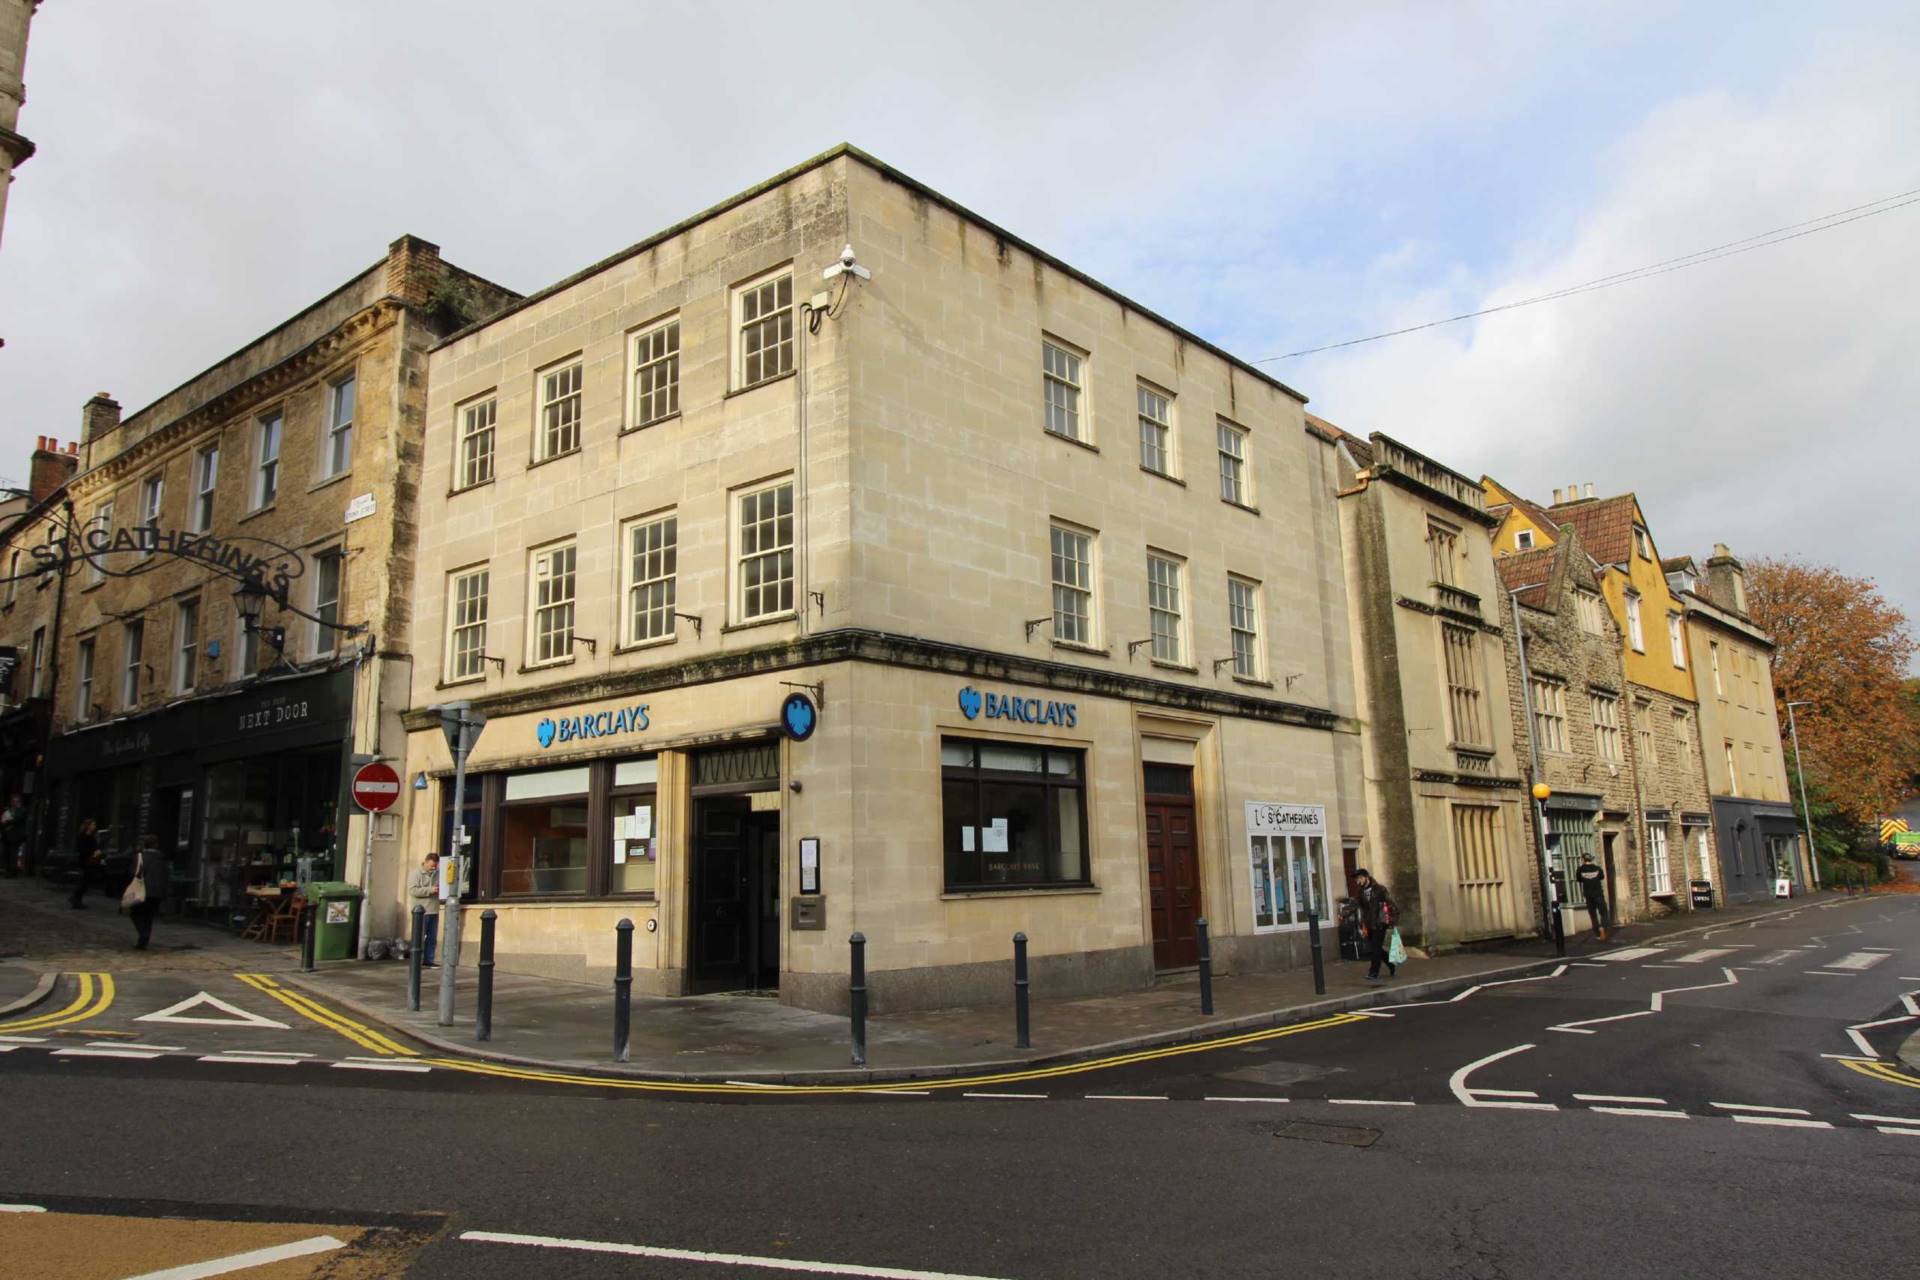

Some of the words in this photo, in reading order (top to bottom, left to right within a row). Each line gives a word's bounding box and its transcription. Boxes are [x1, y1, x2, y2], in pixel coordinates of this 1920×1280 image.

[239, 710, 270, 730] NEXT
[276, 701, 308, 722] DOOR
[559, 704, 650, 742] BARCLAYS
[985, 692, 1077, 728] BARCLAYS
